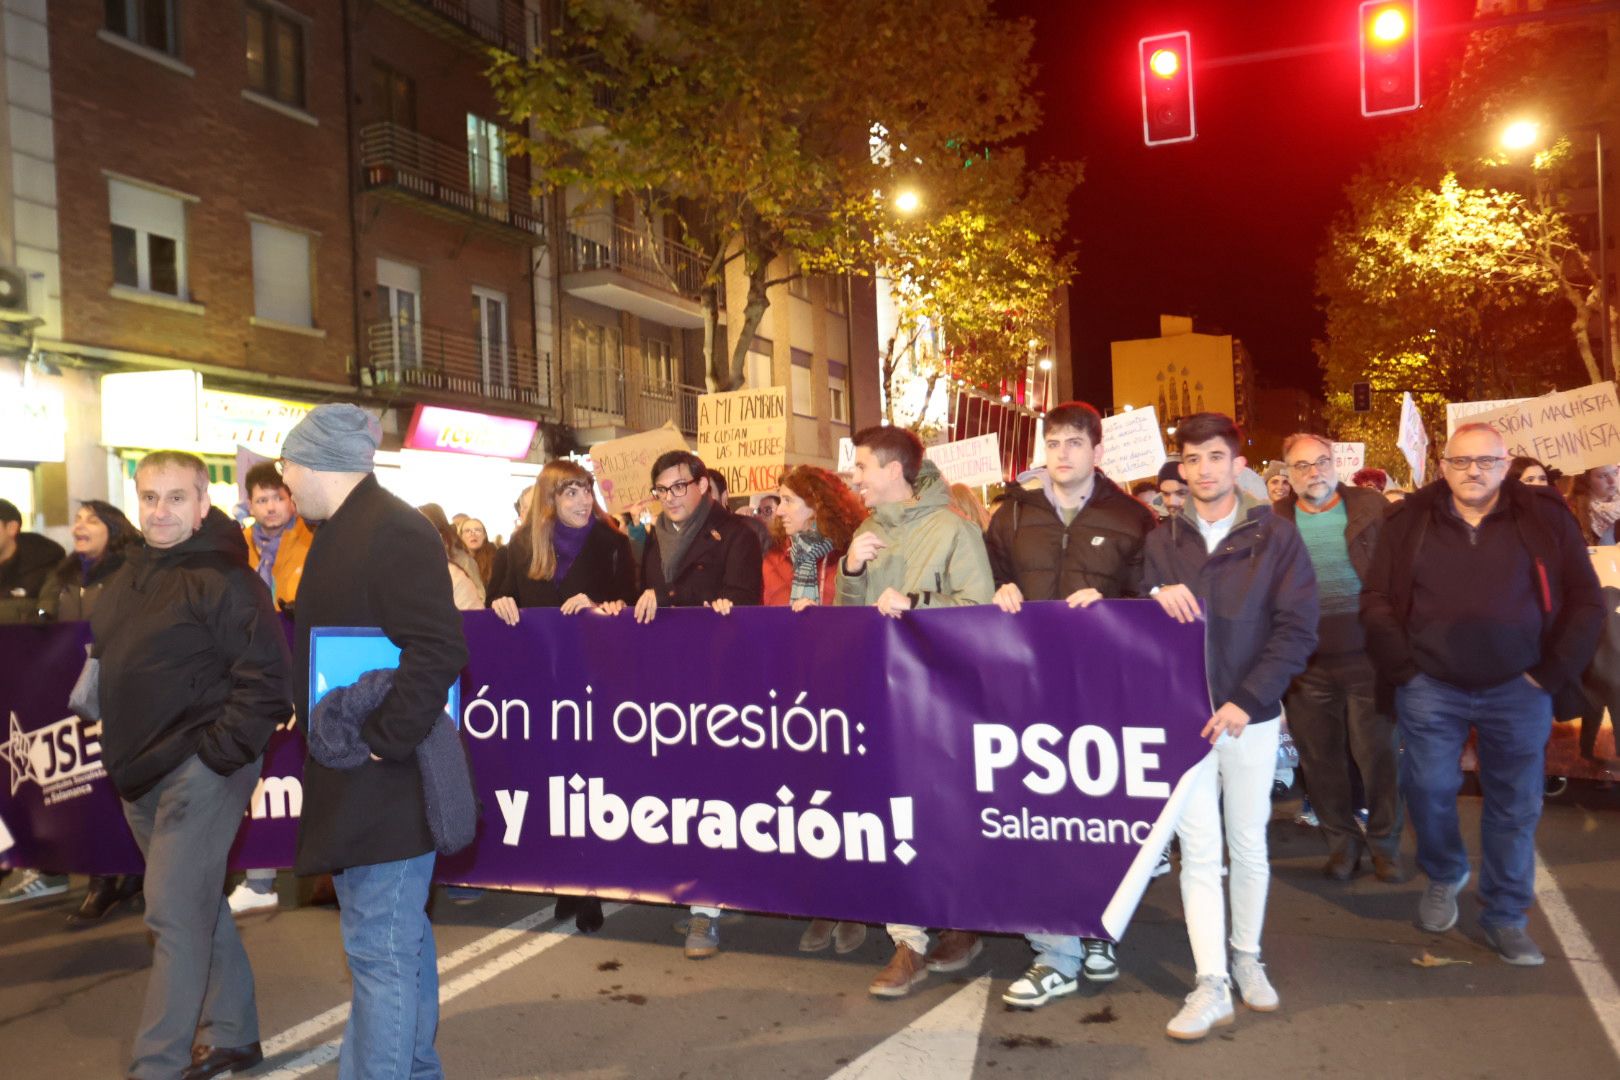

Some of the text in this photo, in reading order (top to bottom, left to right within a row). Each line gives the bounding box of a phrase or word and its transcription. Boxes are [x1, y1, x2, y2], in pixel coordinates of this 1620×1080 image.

[700, 402, 709, 426] A
[715, 398, 731, 425] MI
[1541, 393, 1614, 424] MACHISTA
[699, 432, 710, 444] ME
[716, 436, 784, 460] LAS MUJERES
[1533, 422, 1620, 460] FEMINISTA
[463, 684, 867, 757] ón ni opresión:
[973, 723, 1171, 798] PSOE
[494, 773, 918, 865] y liberación!
[980, 807, 1156, 845] Salamanc
